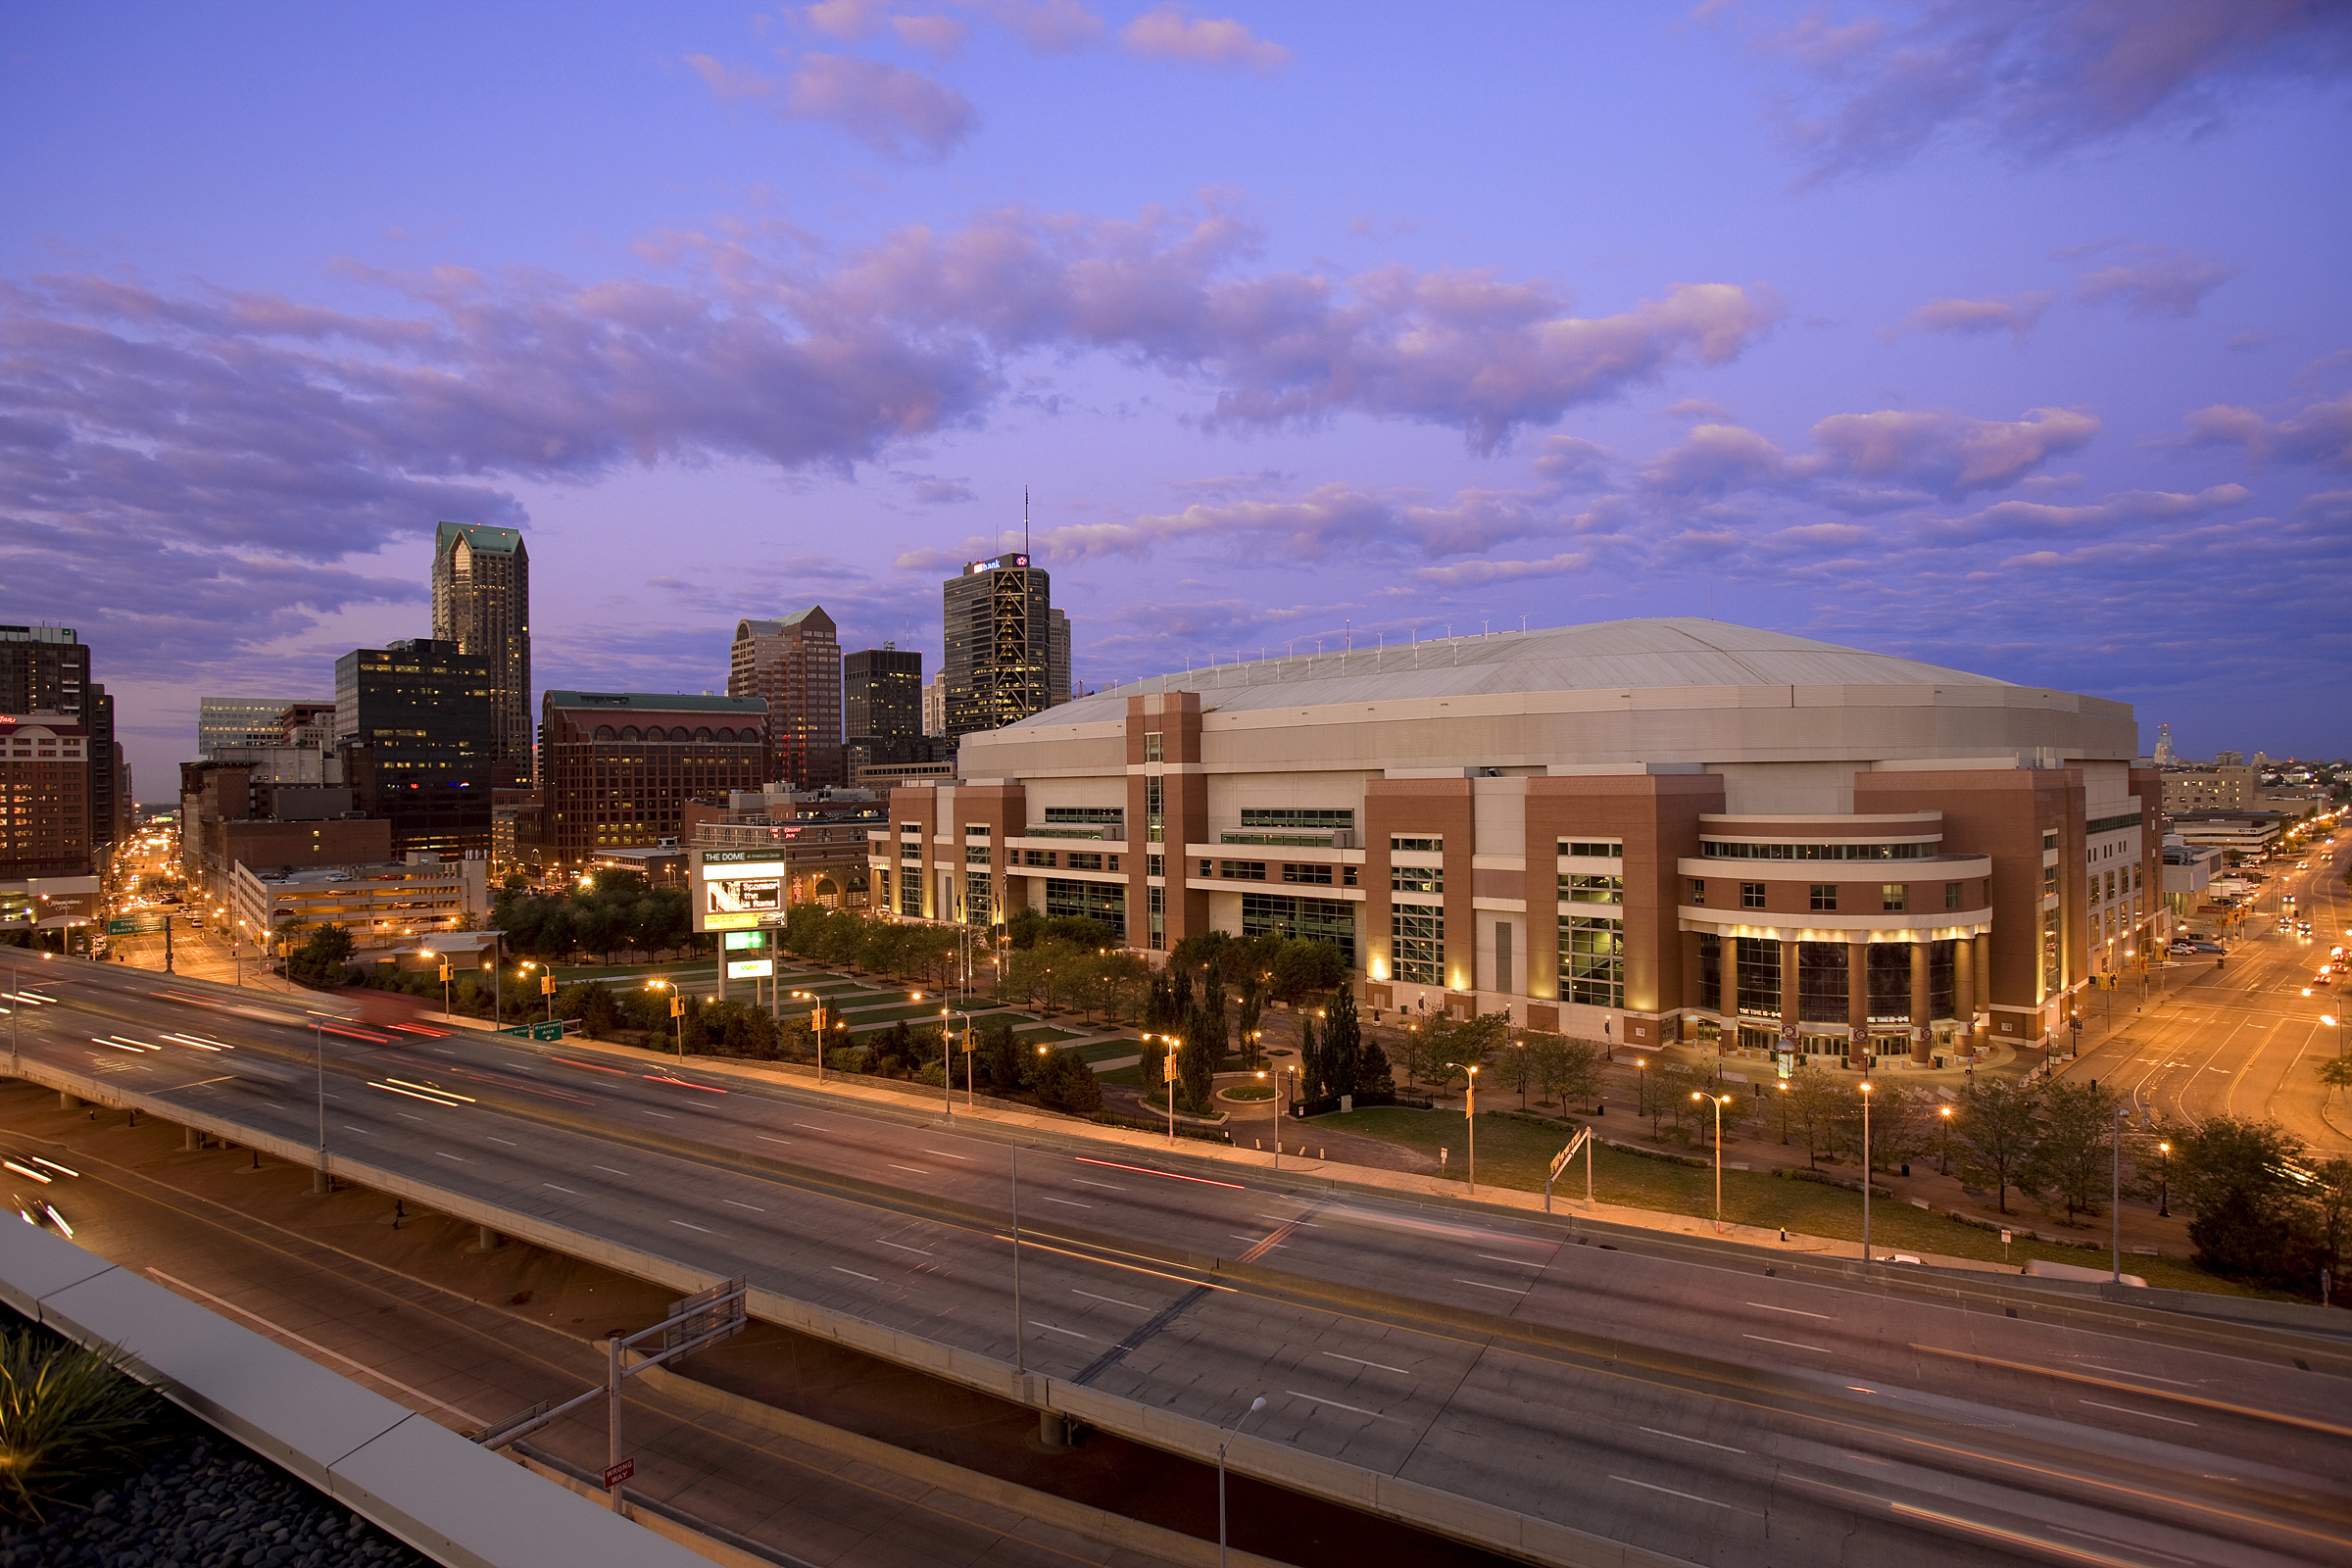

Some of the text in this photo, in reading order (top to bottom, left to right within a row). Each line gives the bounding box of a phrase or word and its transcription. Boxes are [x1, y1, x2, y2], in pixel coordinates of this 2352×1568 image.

[743, 883, 778, 892] Sponsor
[534, 1022, 561, 1031] Riverfront
[607, 1460, 632, 1478] WRONG
[612, 1471, 628, 1484] WAY
